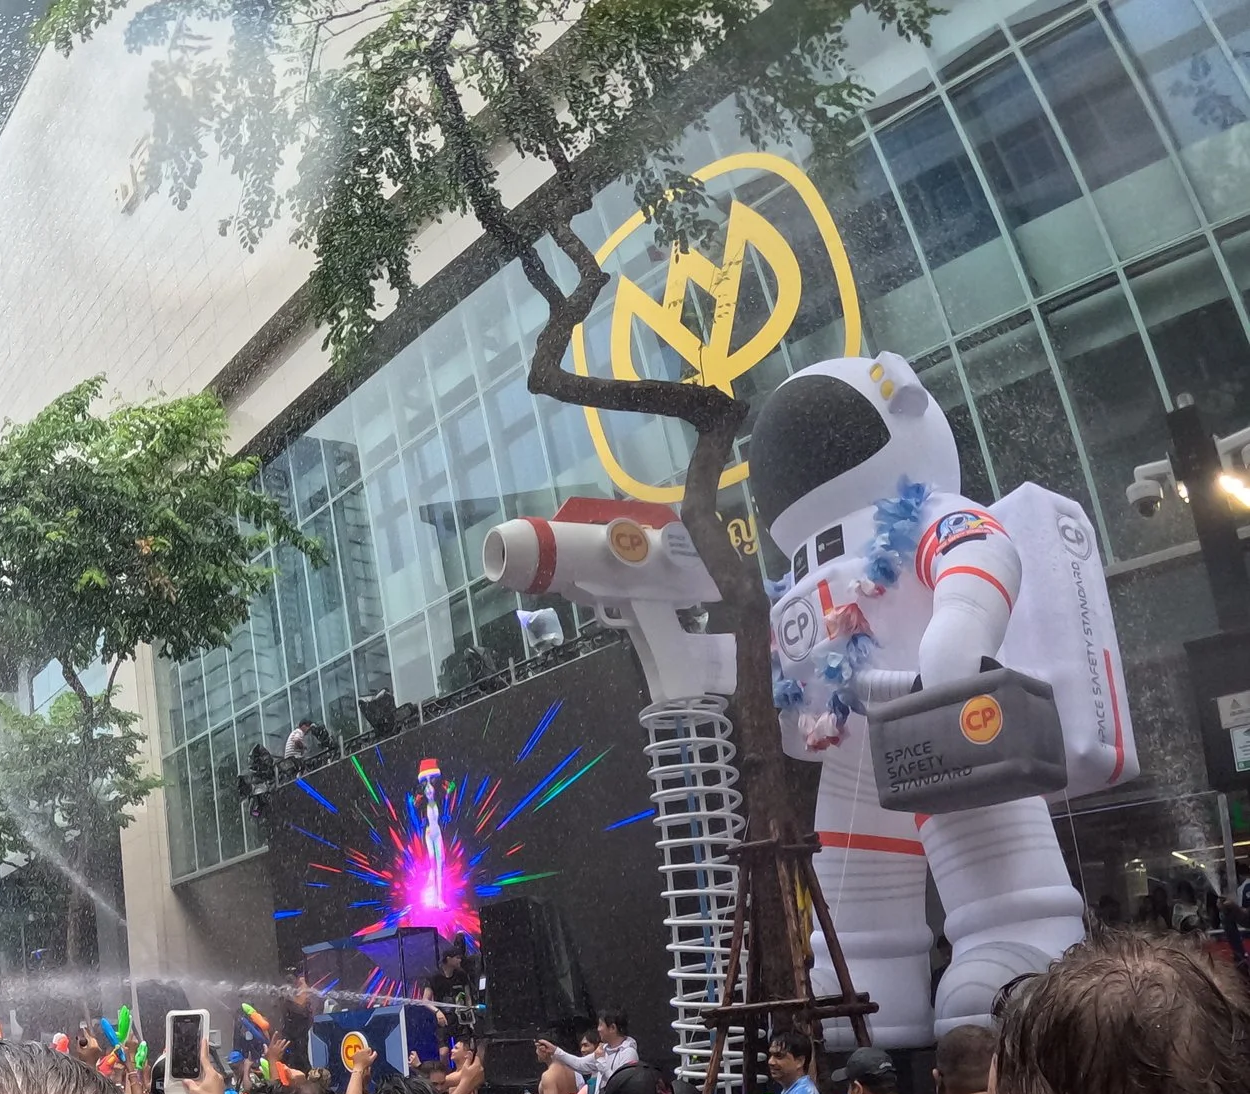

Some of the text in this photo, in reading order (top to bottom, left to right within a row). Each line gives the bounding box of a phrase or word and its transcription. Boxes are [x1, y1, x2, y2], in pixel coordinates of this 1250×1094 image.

[615, 533, 643, 550] CP
[1071, 560, 1093, 636] STANDARD
[783, 612, 809, 646] CP
[1086, 639, 1102, 696] SAFETY
[965, 707, 996, 731] CP
[884, 741, 932, 764] SPACE
[887, 755, 944, 780] SAFETY
[890, 766, 973, 794] STANDARD
